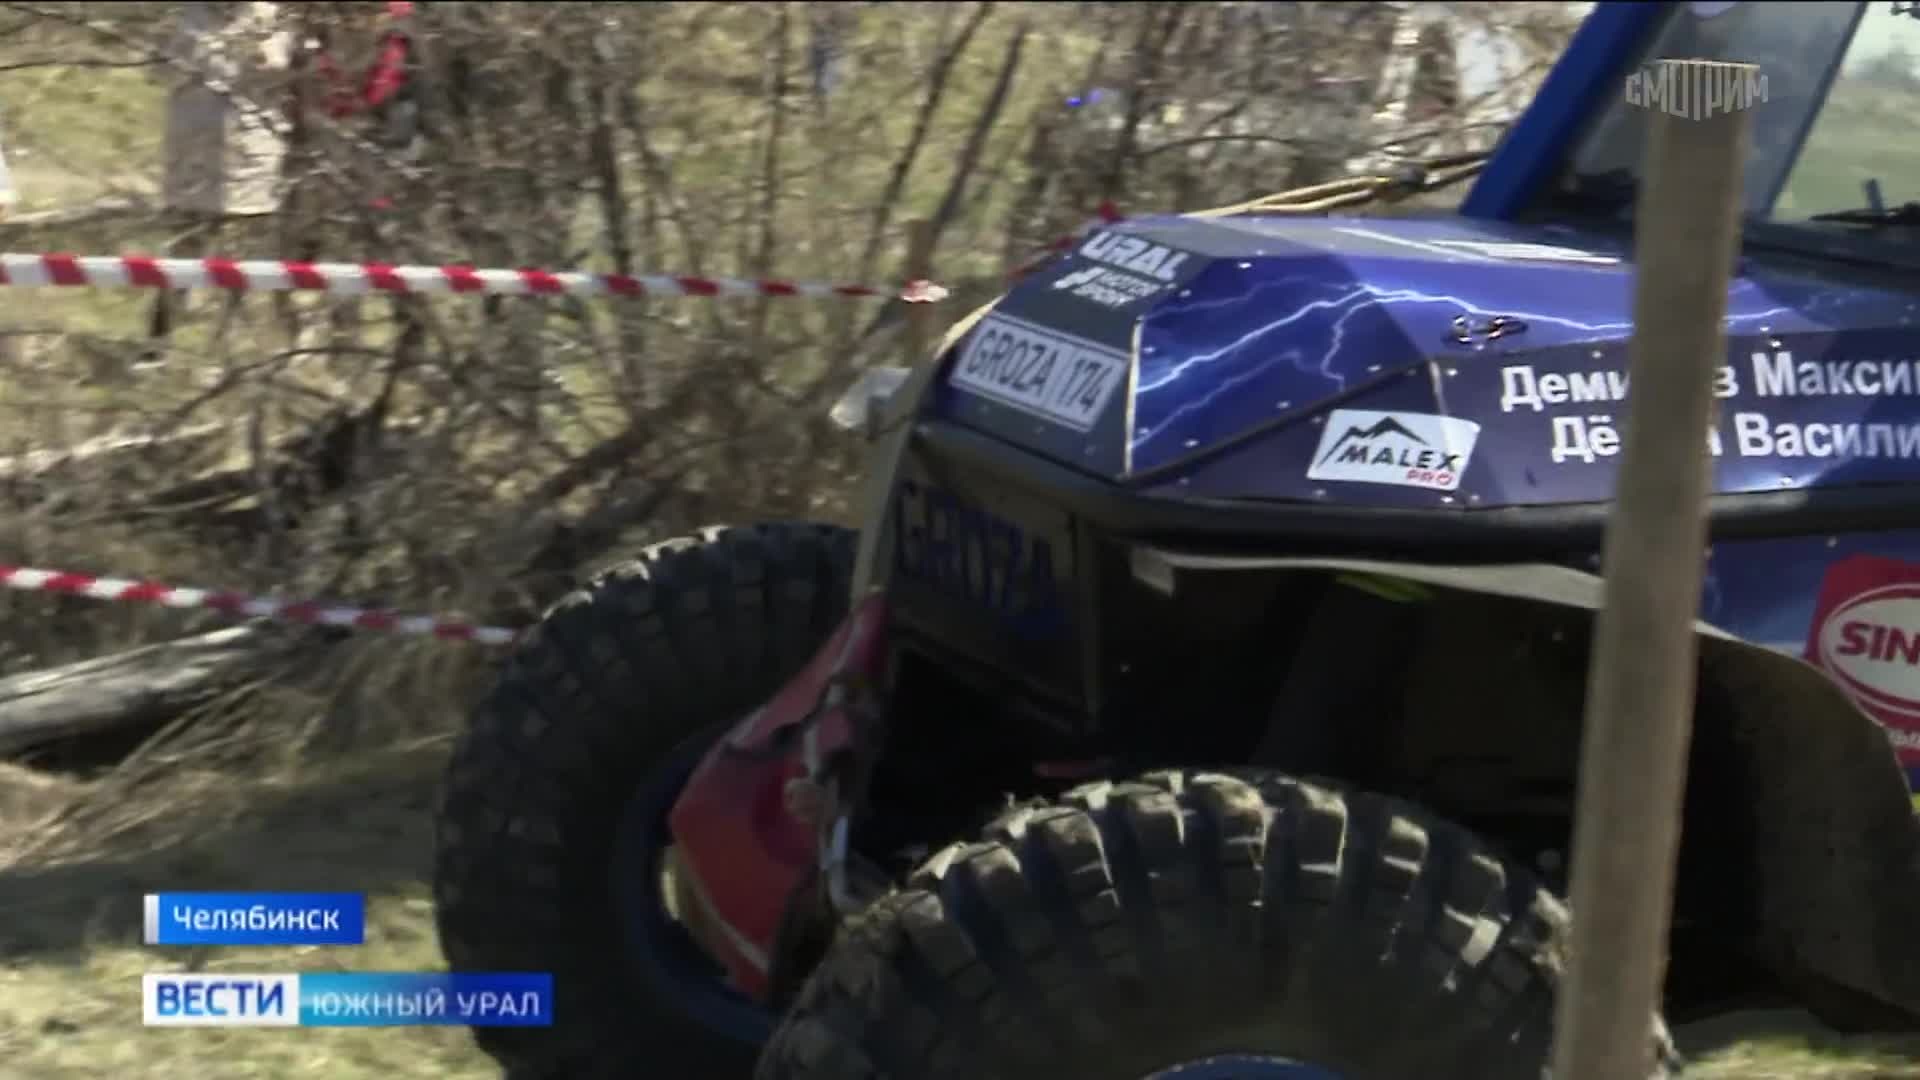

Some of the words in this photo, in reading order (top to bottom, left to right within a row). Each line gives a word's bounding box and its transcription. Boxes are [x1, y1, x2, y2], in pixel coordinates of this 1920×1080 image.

[1079, 231, 1188, 281] URAL
[967, 329, 1059, 397] GROZA
[1055, 359, 1113, 413] 174
[1501, 365, 1739, 412] Демив
[1752, 351, 1920, 396] Макси
[1337, 445, 1463, 472] MALEX
